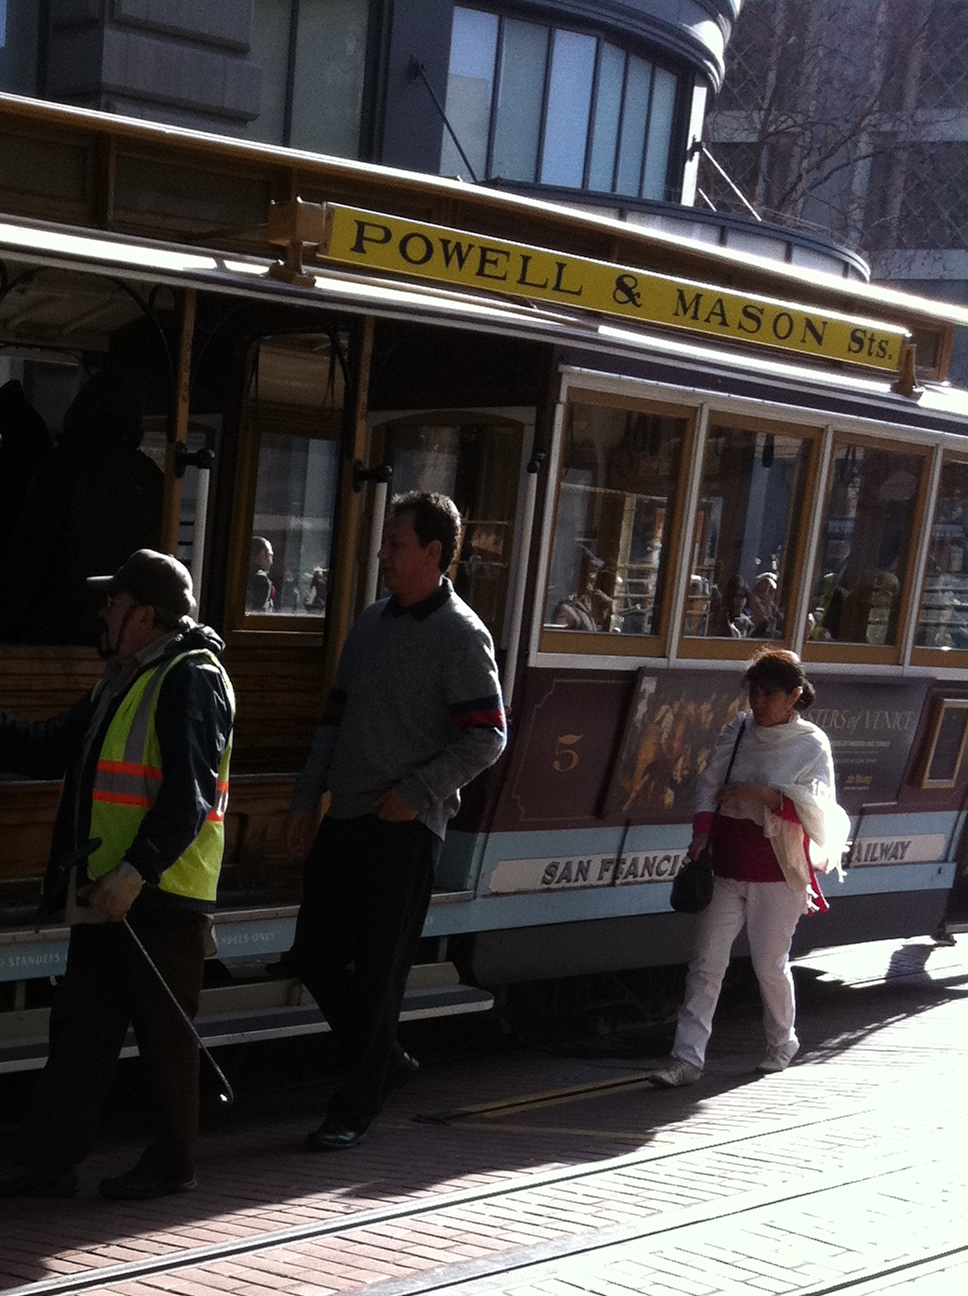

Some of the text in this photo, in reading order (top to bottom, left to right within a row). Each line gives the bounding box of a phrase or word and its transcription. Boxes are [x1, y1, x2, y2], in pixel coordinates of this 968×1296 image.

[350, 219, 893, 360] POWELL & MASON Sts.
[552, 735, 583, 772] 5
[540, 859, 592, 886] SAN
[843, 840, 912, 867] AILWAY
[252, 931, 275, 943] ONLY
[9, 953, 61, 968] STANDEES
